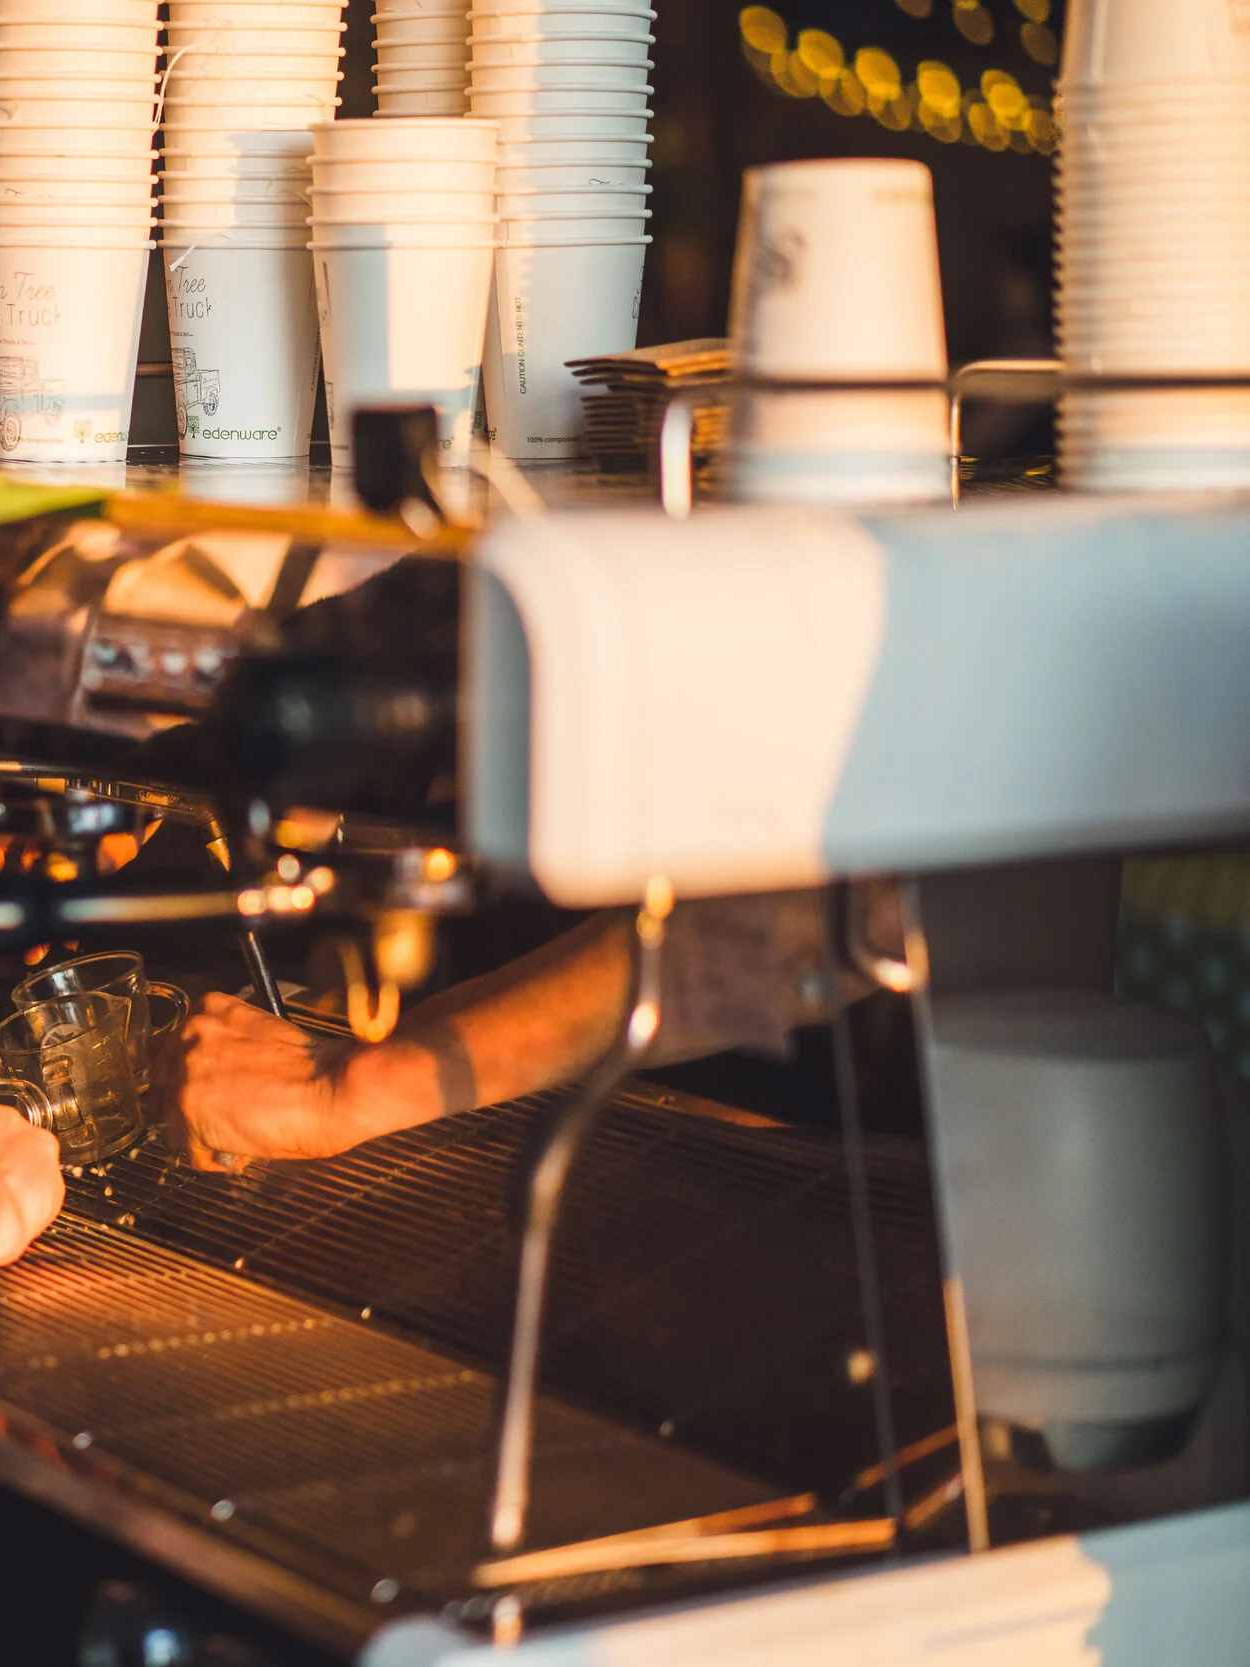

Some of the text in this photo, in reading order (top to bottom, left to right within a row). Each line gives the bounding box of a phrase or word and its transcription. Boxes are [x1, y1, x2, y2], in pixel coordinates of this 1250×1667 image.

[13, 271, 56, 300] Tree
[175, 265, 207, 294] Tree
[6, 303, 62, 327] Truck
[516, 315, 525, 357] CONTENTS
[519, 359, 527, 394] CAUTION
